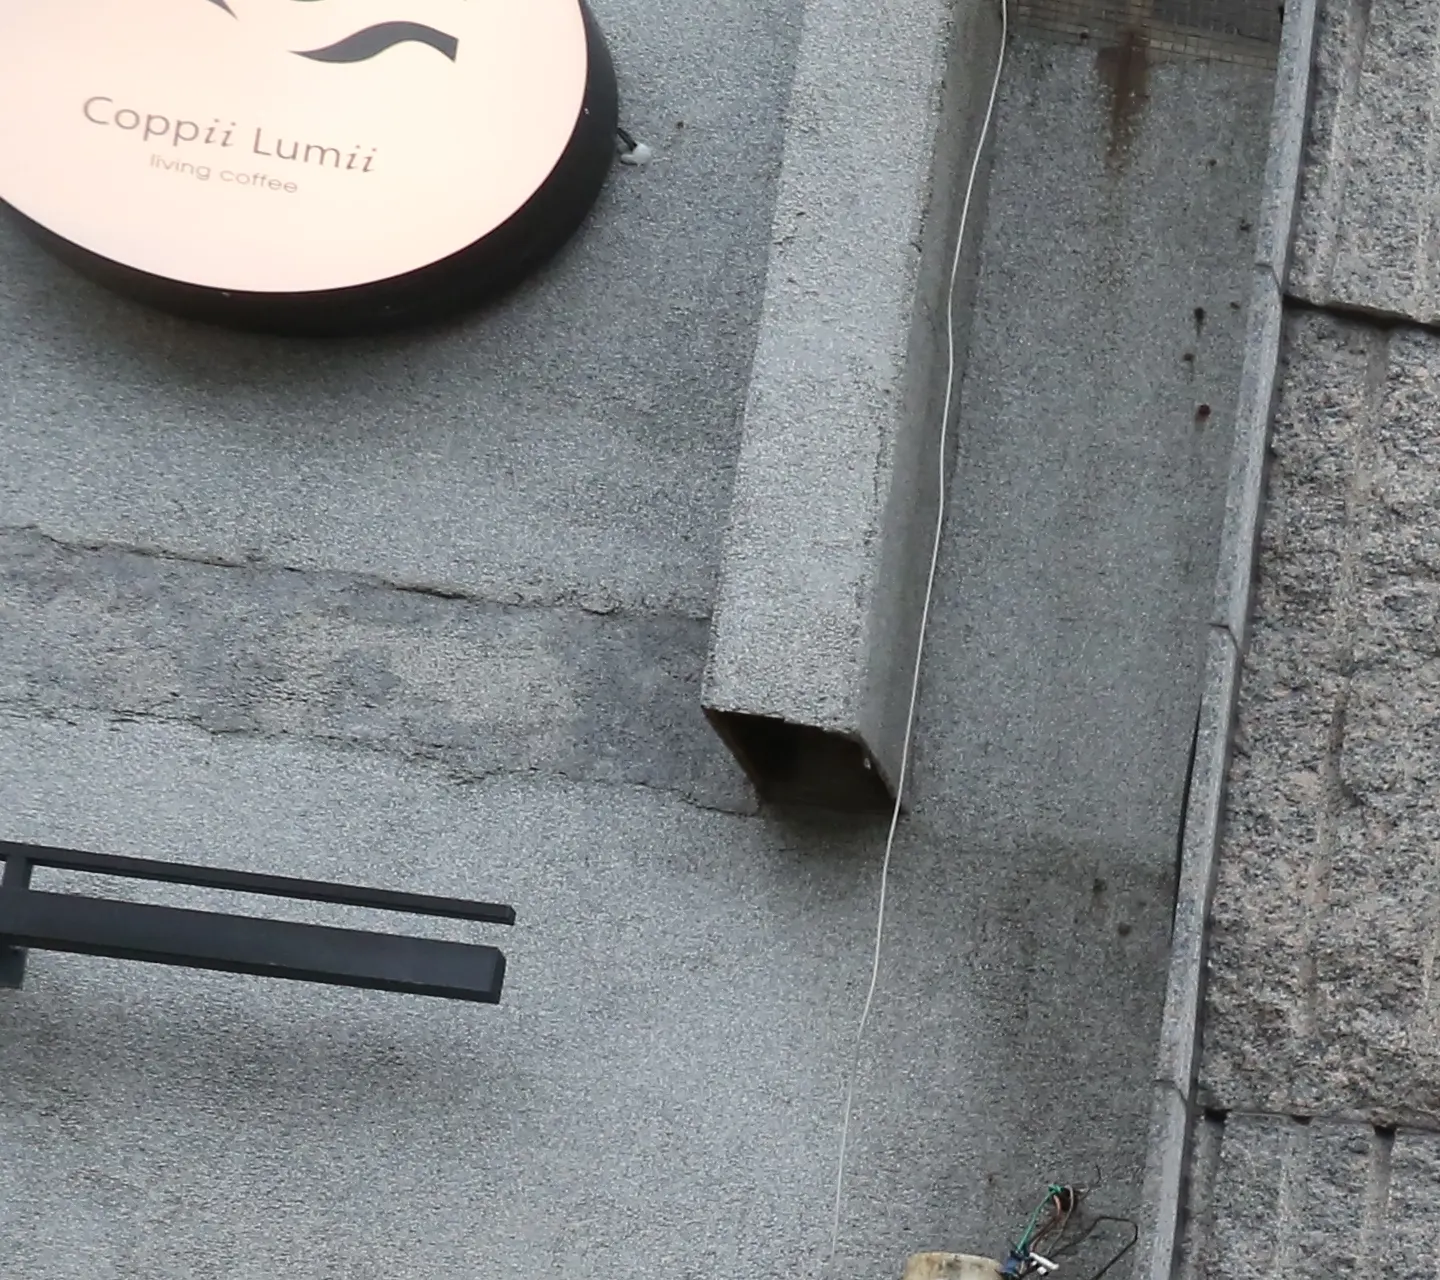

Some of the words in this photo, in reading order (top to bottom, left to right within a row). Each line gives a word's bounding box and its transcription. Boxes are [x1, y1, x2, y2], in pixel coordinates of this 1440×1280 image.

[82, 94, 236, 149] Coppii
[252, 126, 379, 173] Lumii
[149, 154, 211, 181] living
[220, 167, 298, 194] coffee
